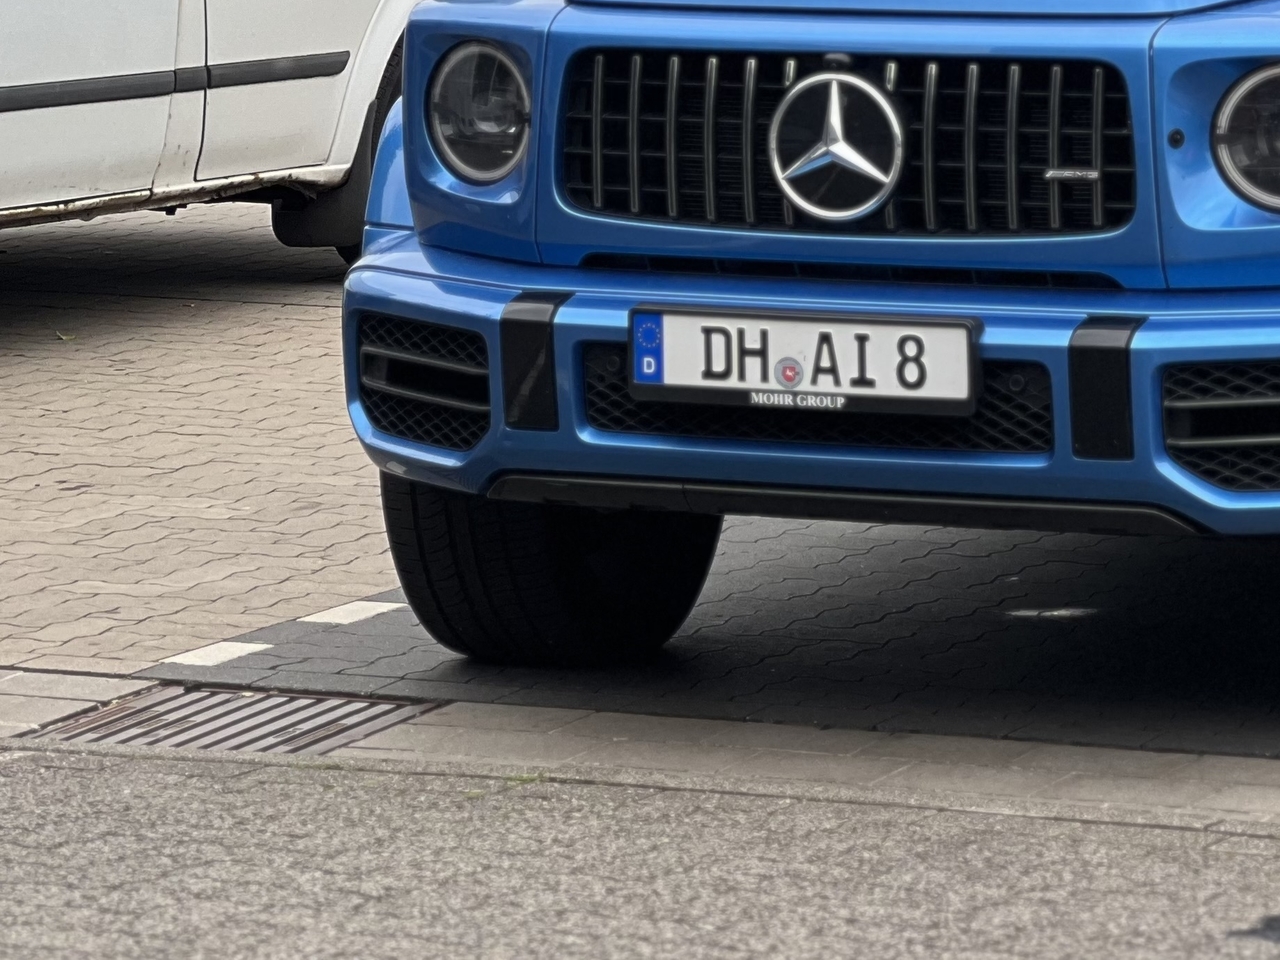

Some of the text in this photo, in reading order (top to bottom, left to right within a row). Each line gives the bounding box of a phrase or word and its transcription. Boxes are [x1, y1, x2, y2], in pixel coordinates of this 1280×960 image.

[643, 357, 655, 373] D
[701, 325, 928, 390] DH AI 8
[751, 393, 845, 408] MOHR GROUP
